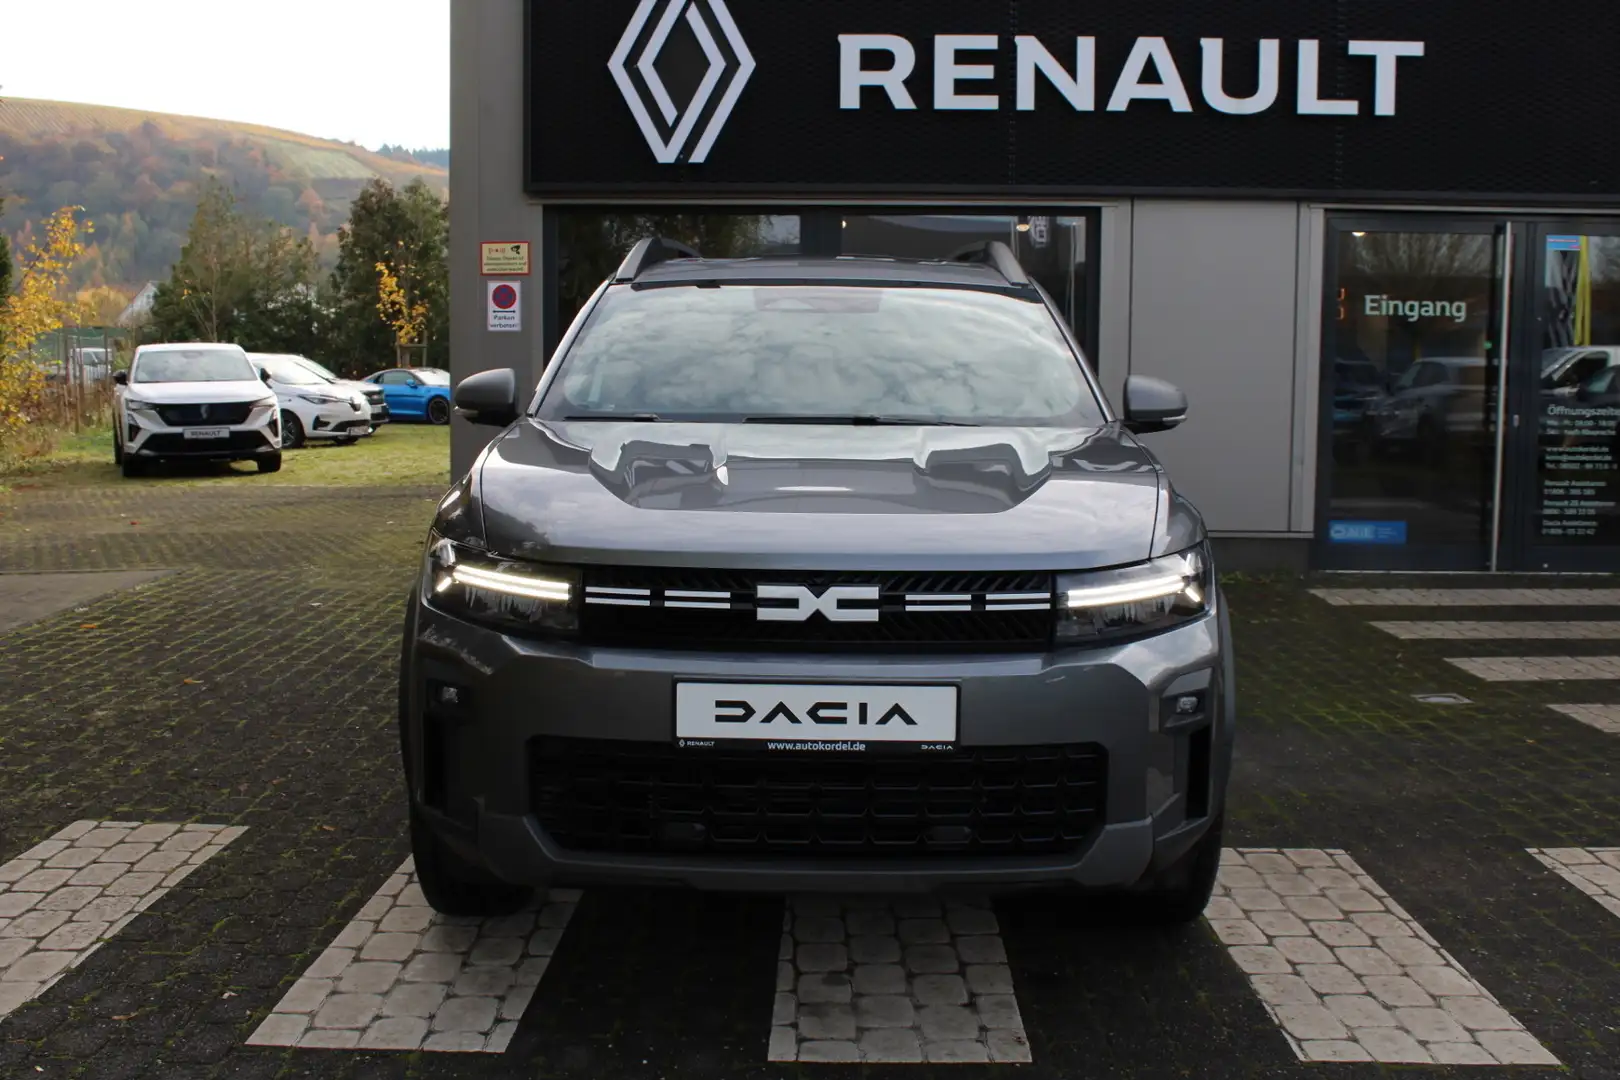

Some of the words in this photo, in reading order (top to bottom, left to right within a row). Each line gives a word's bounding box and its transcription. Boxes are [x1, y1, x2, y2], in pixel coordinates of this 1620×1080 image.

[838, 33, 1425, 116] RENAULT
[1364, 294, 1467, 322] Eingang
[715, 700, 918, 725] DACIA
[767, 741, 866, 751] www.autokordel.de
